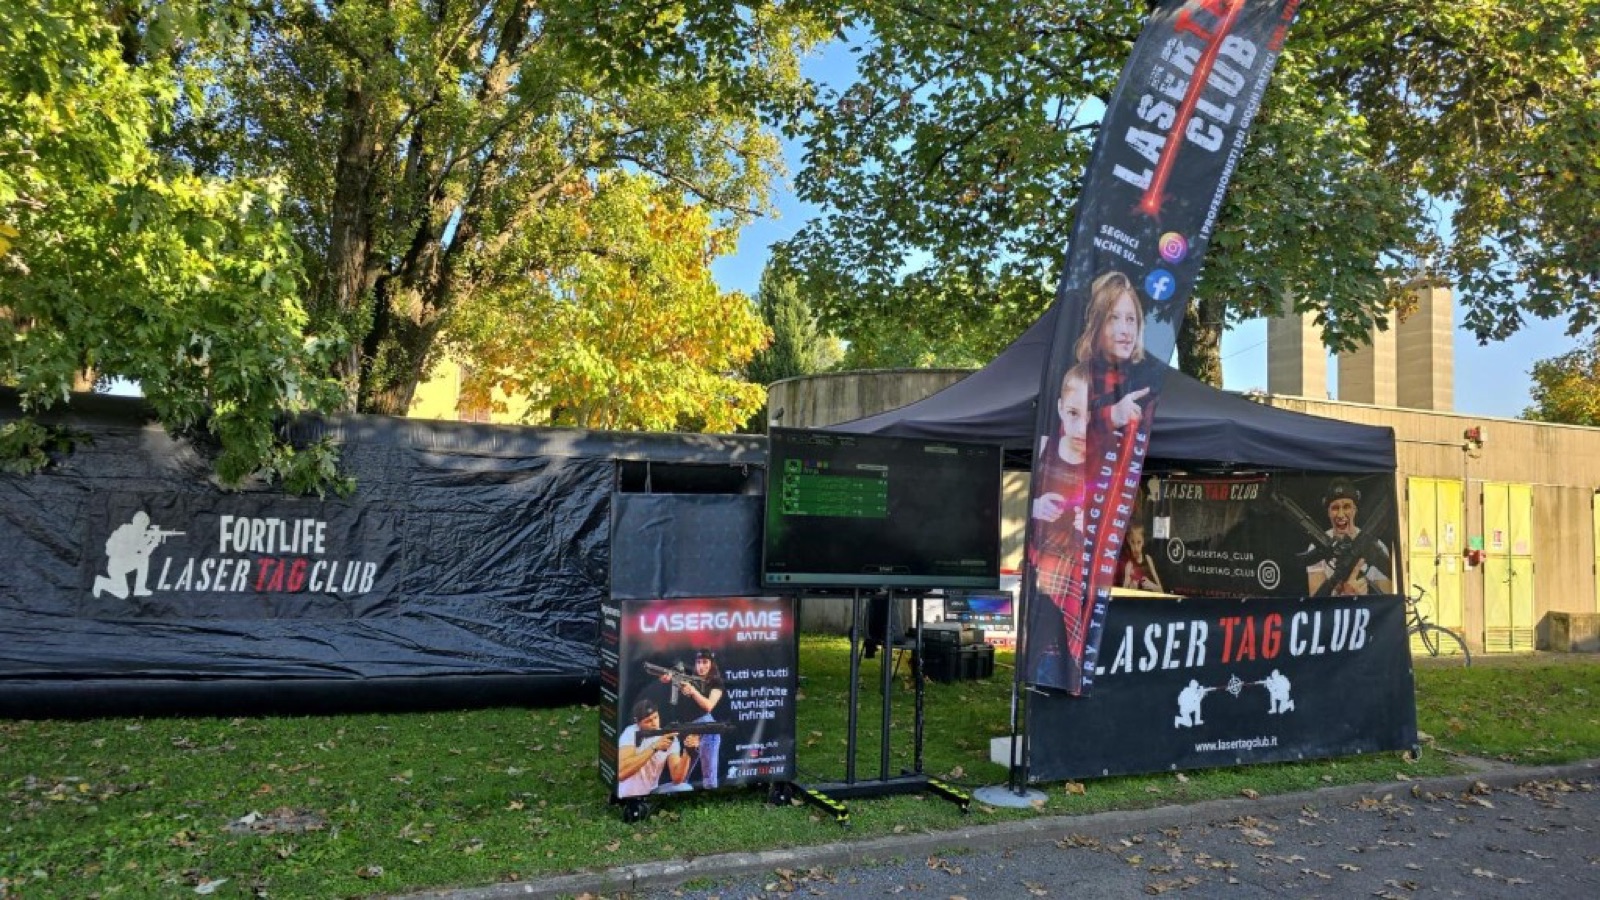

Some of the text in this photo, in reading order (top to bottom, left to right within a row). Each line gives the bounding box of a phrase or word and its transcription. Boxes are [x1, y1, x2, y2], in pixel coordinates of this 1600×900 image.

[1112, 38, 1201, 190] LASER
[1185, 35, 1257, 152] CLUB
[1200, 148, 1239, 234] PROFESSIONISTI
[1093, 237, 1122, 255] NCHE
[1100, 224, 1139, 249] SEGUICI
[1163, 483, 1202, 500] LASER
[1230, 483, 1259, 500] CLUB
[219, 515, 327, 553] FORTLIFE
[1083, 432, 1147, 686] TRY THE EXPERIENCE
[157, 557, 378, 593] LASER TAG CLUB
[640, 611, 782, 633] LASERGAME
[736, 631, 778, 641] BATTLE
[1095, 608, 1370, 675] ASER TAG CLUB
[725, 667, 789, 680] Tutti vs tutti
[726, 686, 788, 699] Vite infinite
[731, 697, 783, 709] Munizioni
[738, 710, 775, 720] infinite
[1195, 736, 1278, 752] www.lasertagclub.it
